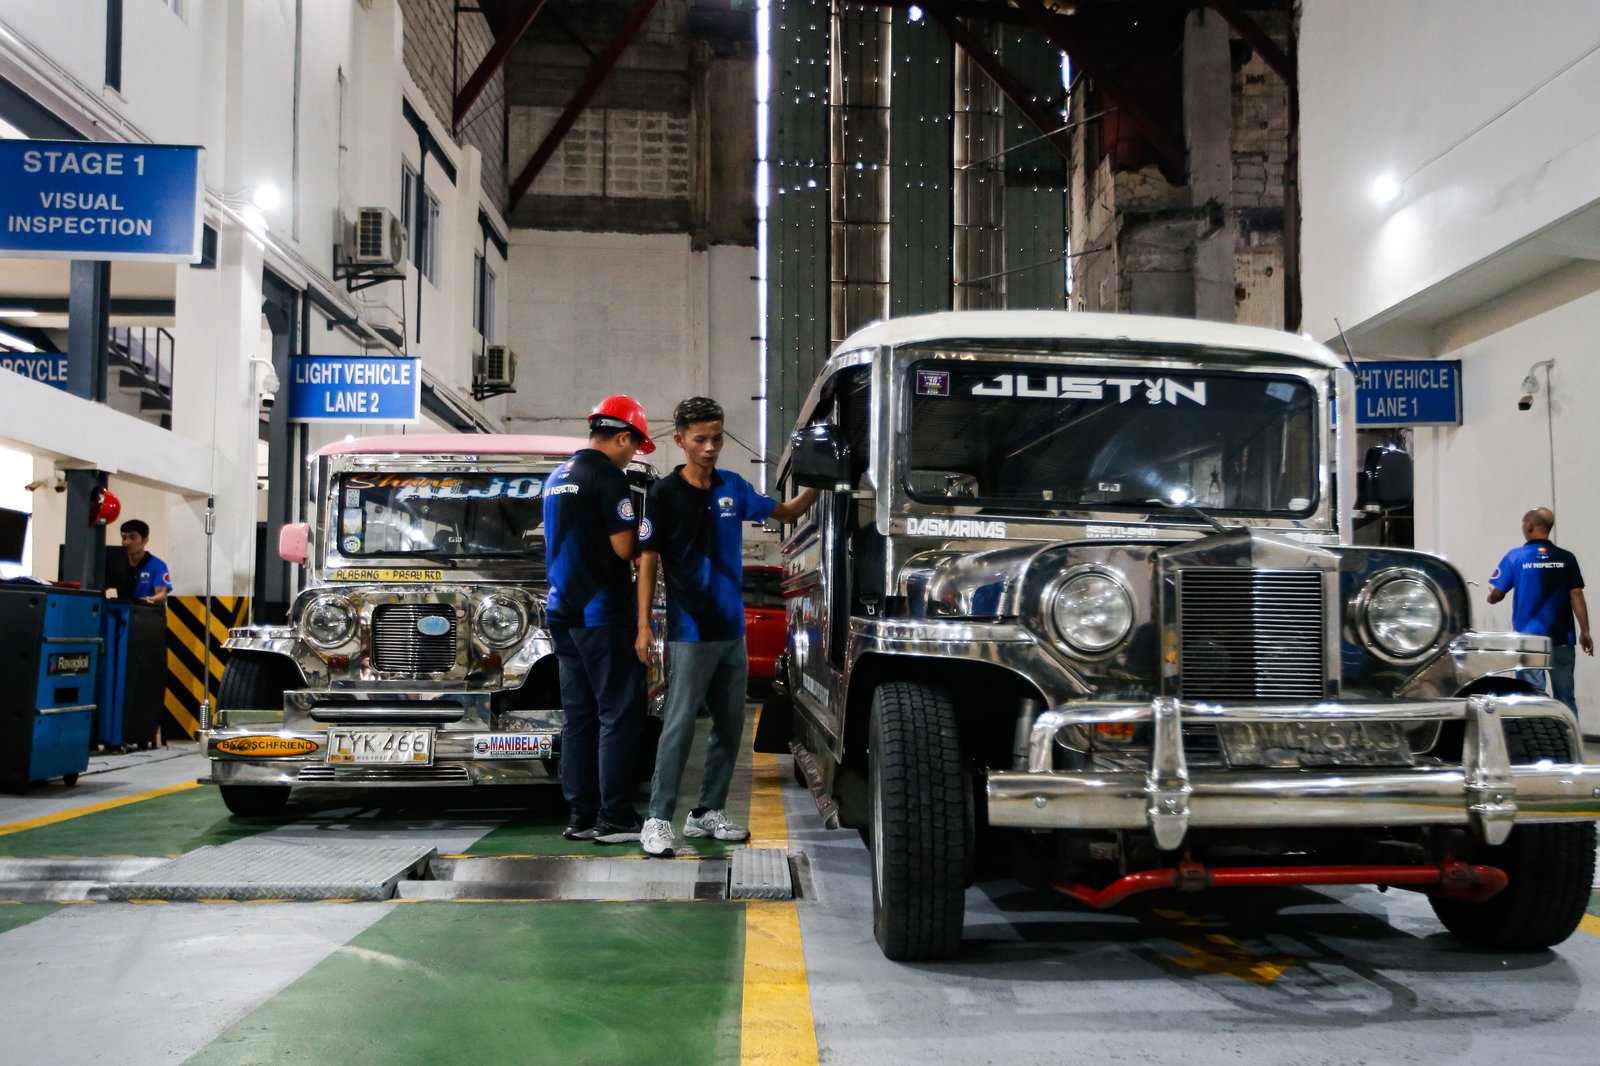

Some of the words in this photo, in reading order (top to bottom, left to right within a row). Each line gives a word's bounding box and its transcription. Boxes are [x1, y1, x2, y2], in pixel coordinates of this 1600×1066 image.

[23, 150, 124, 175] STAGE
[133, 154, 145, 176] 1
[39, 191, 125, 211] VISUAL
[7, 215, 153, 236] INSPECTION
[0, 358, 68, 381] RCYCLE
[296, 362, 342, 385] LIGHT
[344, 363, 411, 386] VEHICLE
[1384, 367, 1449, 390] VEHICLE
[325, 391, 368, 413] LANE
[370, 391, 380, 413] 2
[1367, 396, 1408, 418] LANE
[1410, 397, 1419, 417] 1
[906, 517, 1006, 539] DASMARINAS
[336, 570, 380, 580] ALABANG
[392, 570, 422, 580] PASAY
[334, 732, 378, 753] TYK
[383, 733, 425, 753] 466
[490, 736, 539, 751] MANIBELA
